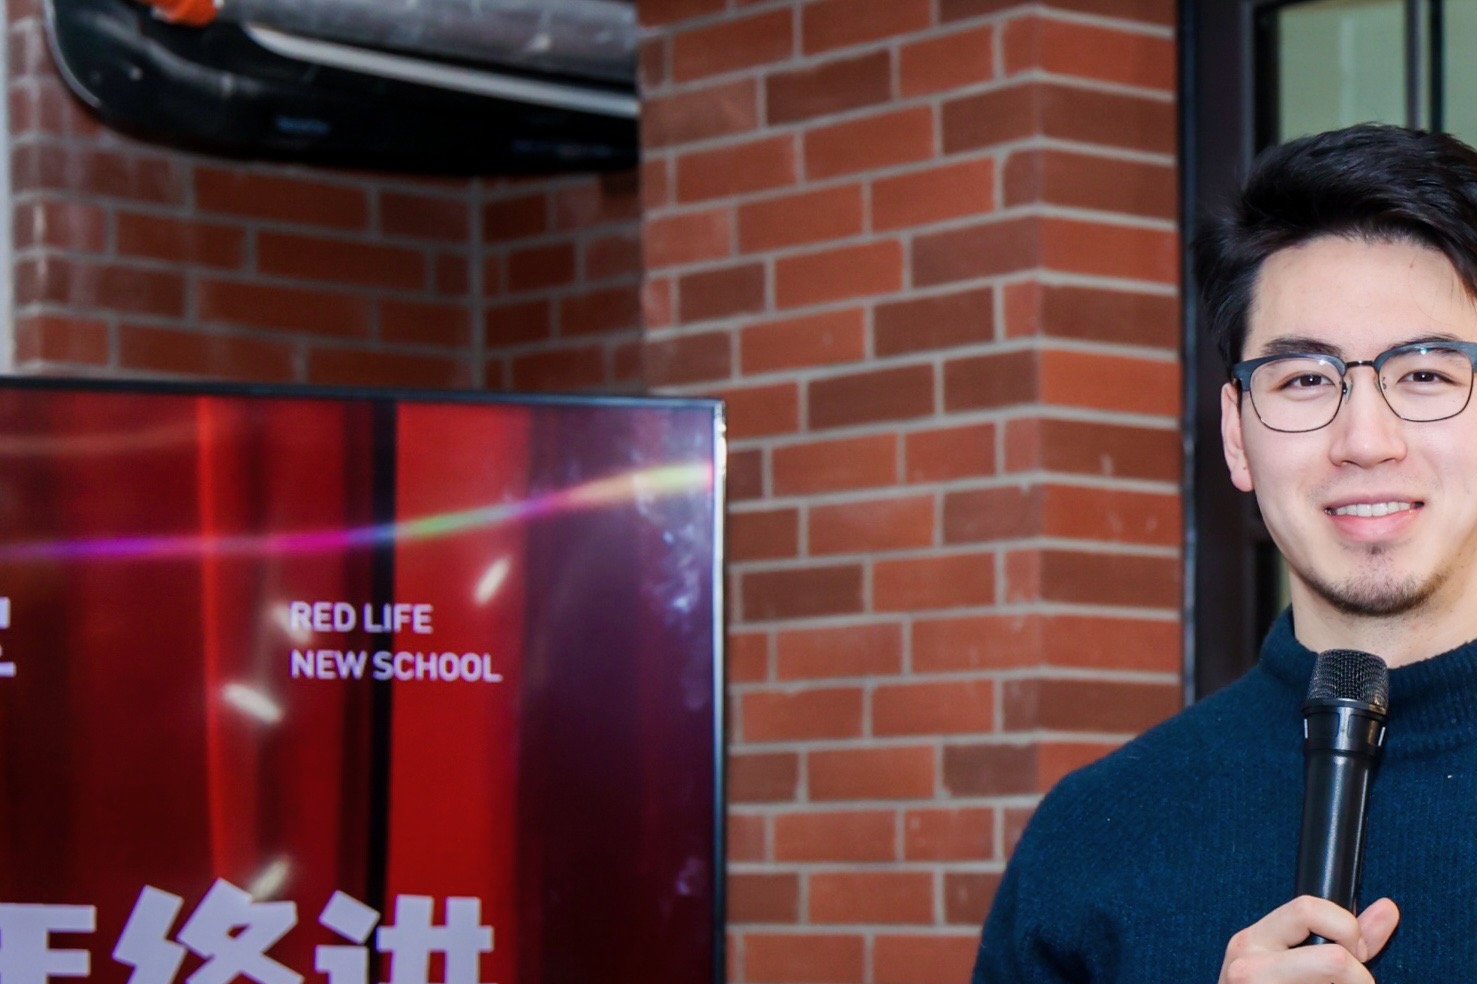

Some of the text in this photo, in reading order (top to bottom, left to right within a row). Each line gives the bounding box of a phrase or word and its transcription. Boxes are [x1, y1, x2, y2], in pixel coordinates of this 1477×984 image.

[290, 600, 434, 634] RED LIFE
[291, 650, 503, 683] NEW SCHOOL
